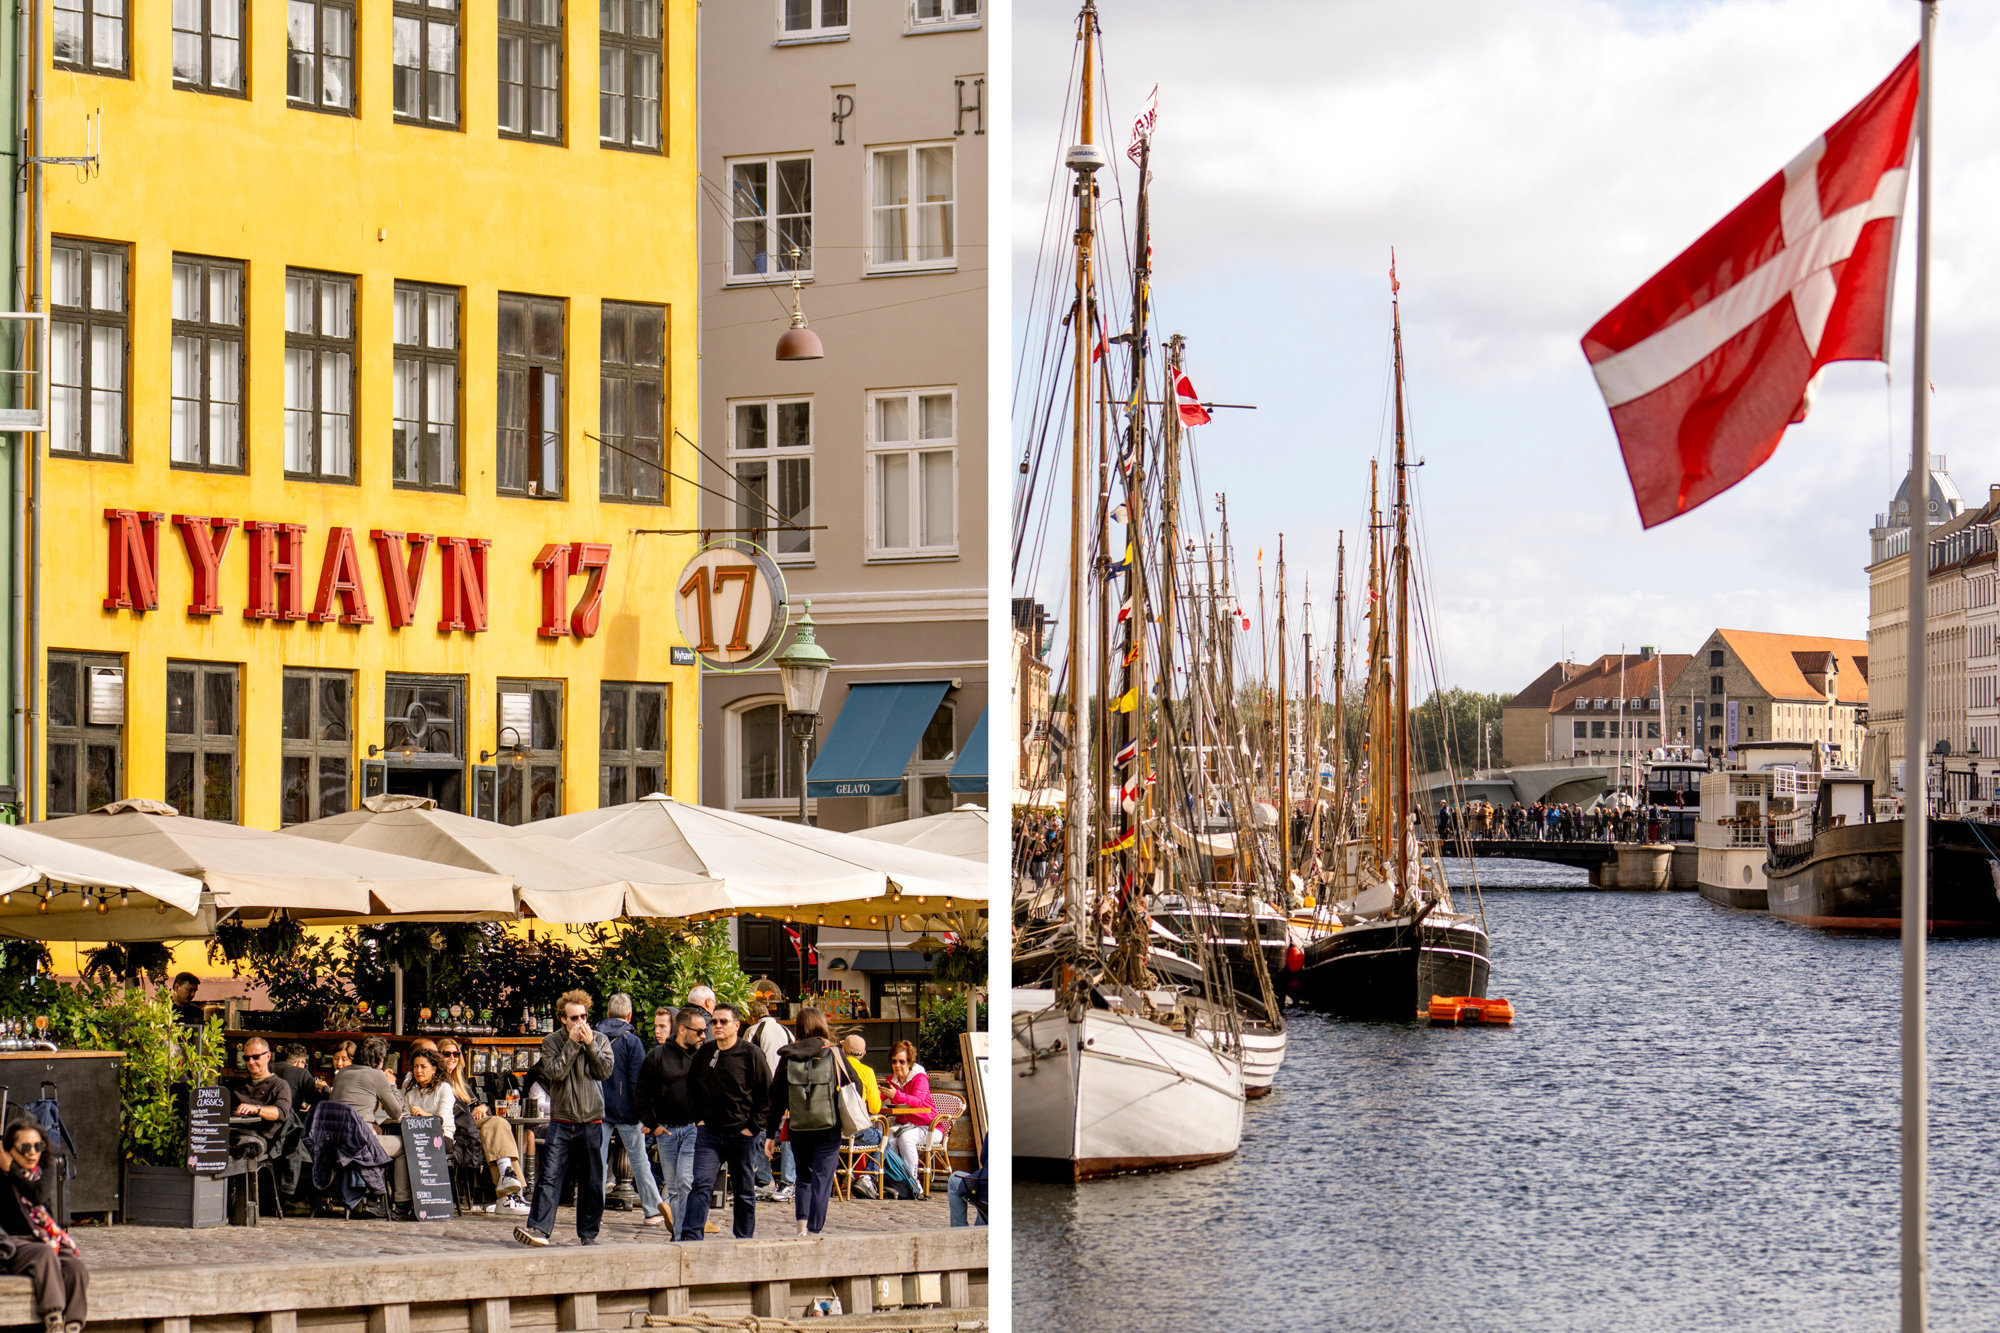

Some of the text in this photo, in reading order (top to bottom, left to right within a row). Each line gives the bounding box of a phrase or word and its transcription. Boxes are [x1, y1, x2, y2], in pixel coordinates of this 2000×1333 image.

[832, 79, 985, 145] P H
[103, 509, 612, 639] NYHAVN 17
[679, 564, 757, 653] 17
[674, 650, 694, 662] Nyhavn
[369, 777, 379, 788] 17
[481, 782, 490, 792] 17
[836, 783, 870, 794] GELATO
[198, 1089, 220, 1099] DANISH
[196, 1098, 224, 1107] CLASSICS
[882, 1280, 890, 1299] 9
